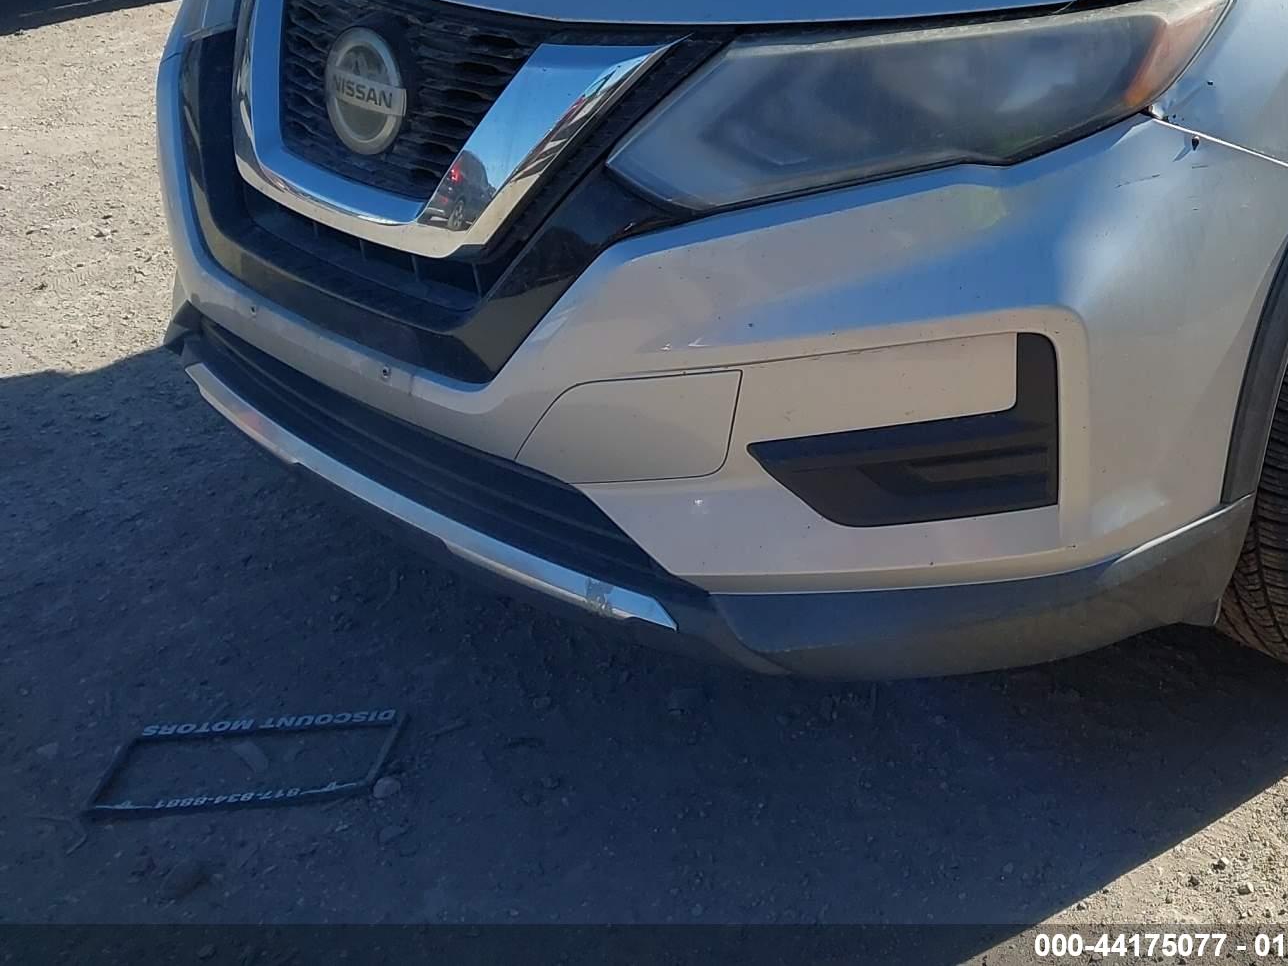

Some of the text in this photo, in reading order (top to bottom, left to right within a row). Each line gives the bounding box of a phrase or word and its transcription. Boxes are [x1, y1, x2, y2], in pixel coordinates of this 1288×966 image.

[332, 74, 393, 109] NISSAN
[142, 709, 397, 737] DISCOUNT MOTORS
